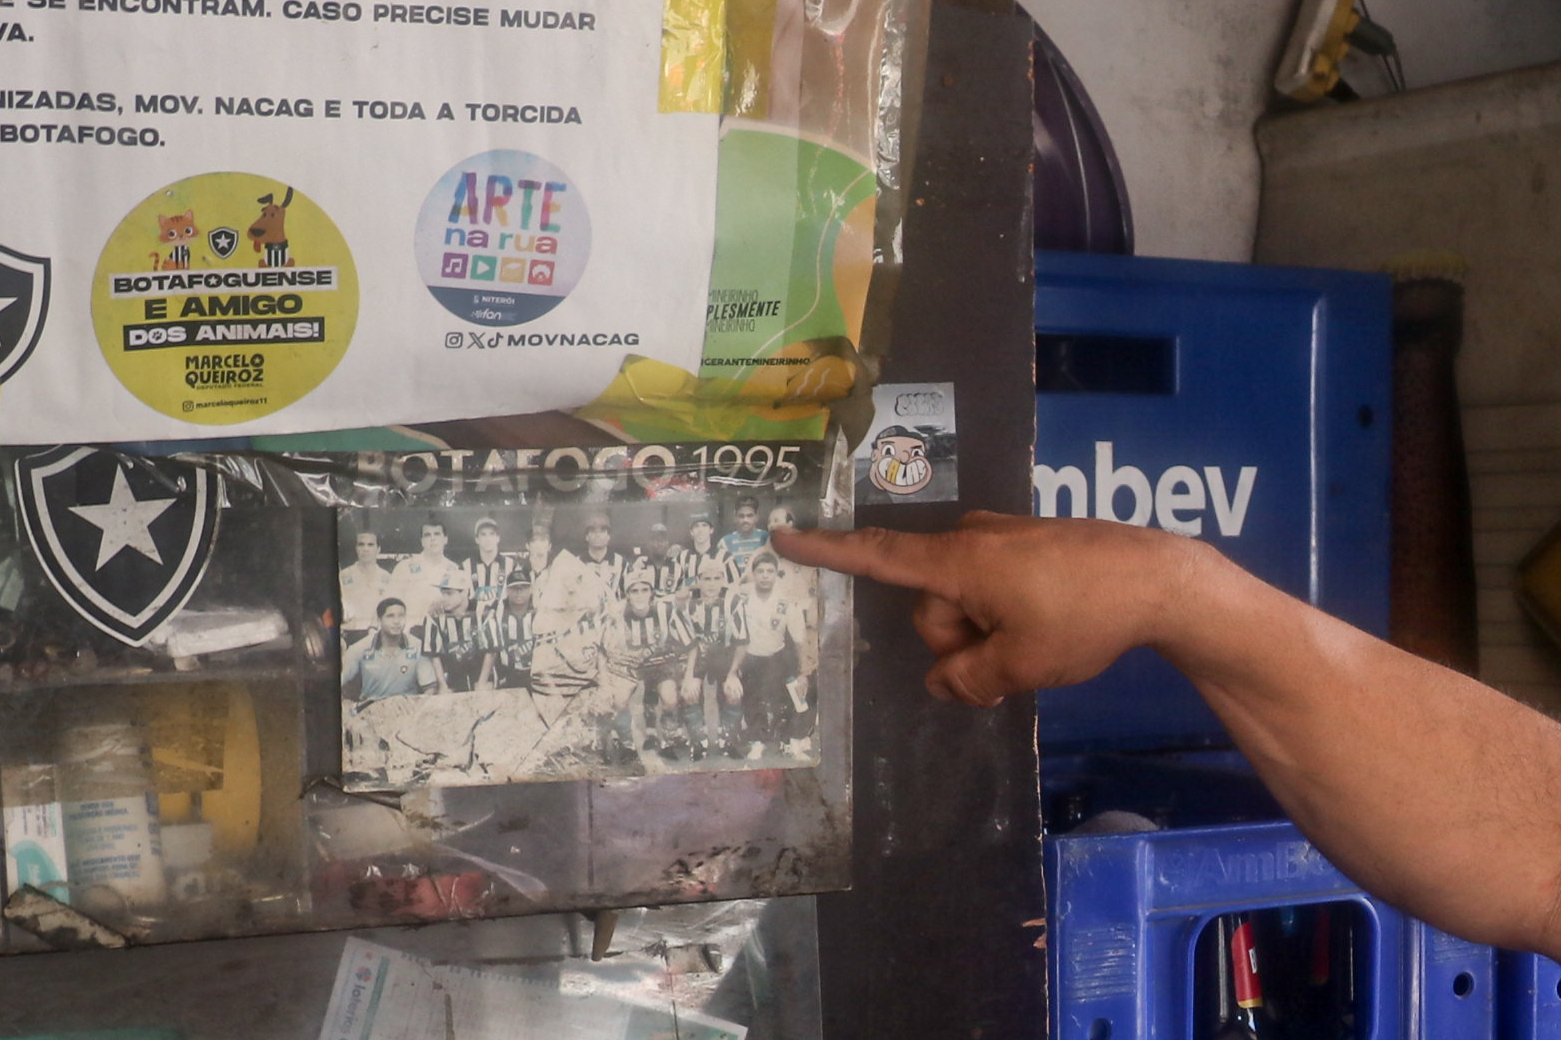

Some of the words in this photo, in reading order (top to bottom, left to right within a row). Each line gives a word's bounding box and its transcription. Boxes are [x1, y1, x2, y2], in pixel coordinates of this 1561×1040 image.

[282, 0, 362, 21] CASO
[373, 4, 489, 27] PRECISE
[500, 9, 596, 31] MUDAR
[0, 90, 124, 116] IZADAS,
[135, 94, 203, 115] MOV.
[215, 96, 314, 118] NACAG
[325, 100, 341, 118] E
[352, 100, 426, 120] TODA
[436, 102, 455, 121] A
[465, 103, 583, 124] TORCIDA
[0, 123, 166, 147] BOTAFOGO.
[447, 171, 567, 234] ARTE
[444, 227, 489, 248] na
[498, 231, 558, 255] rua
[113, 269, 332, 294] BOTAFOGUENSE
[144, 298, 167, 320] E
[180, 294, 303, 318] AMIGO
[128, 325, 187, 347] DOS
[195, 321, 319, 342] ANIMAIS!
[506, 332, 640, 348] MOVNACAG
[185, 353, 265, 371] MARCELO
[185, 368, 264, 389] QUEIROZ
[692, 445, 801, 492] 1995
